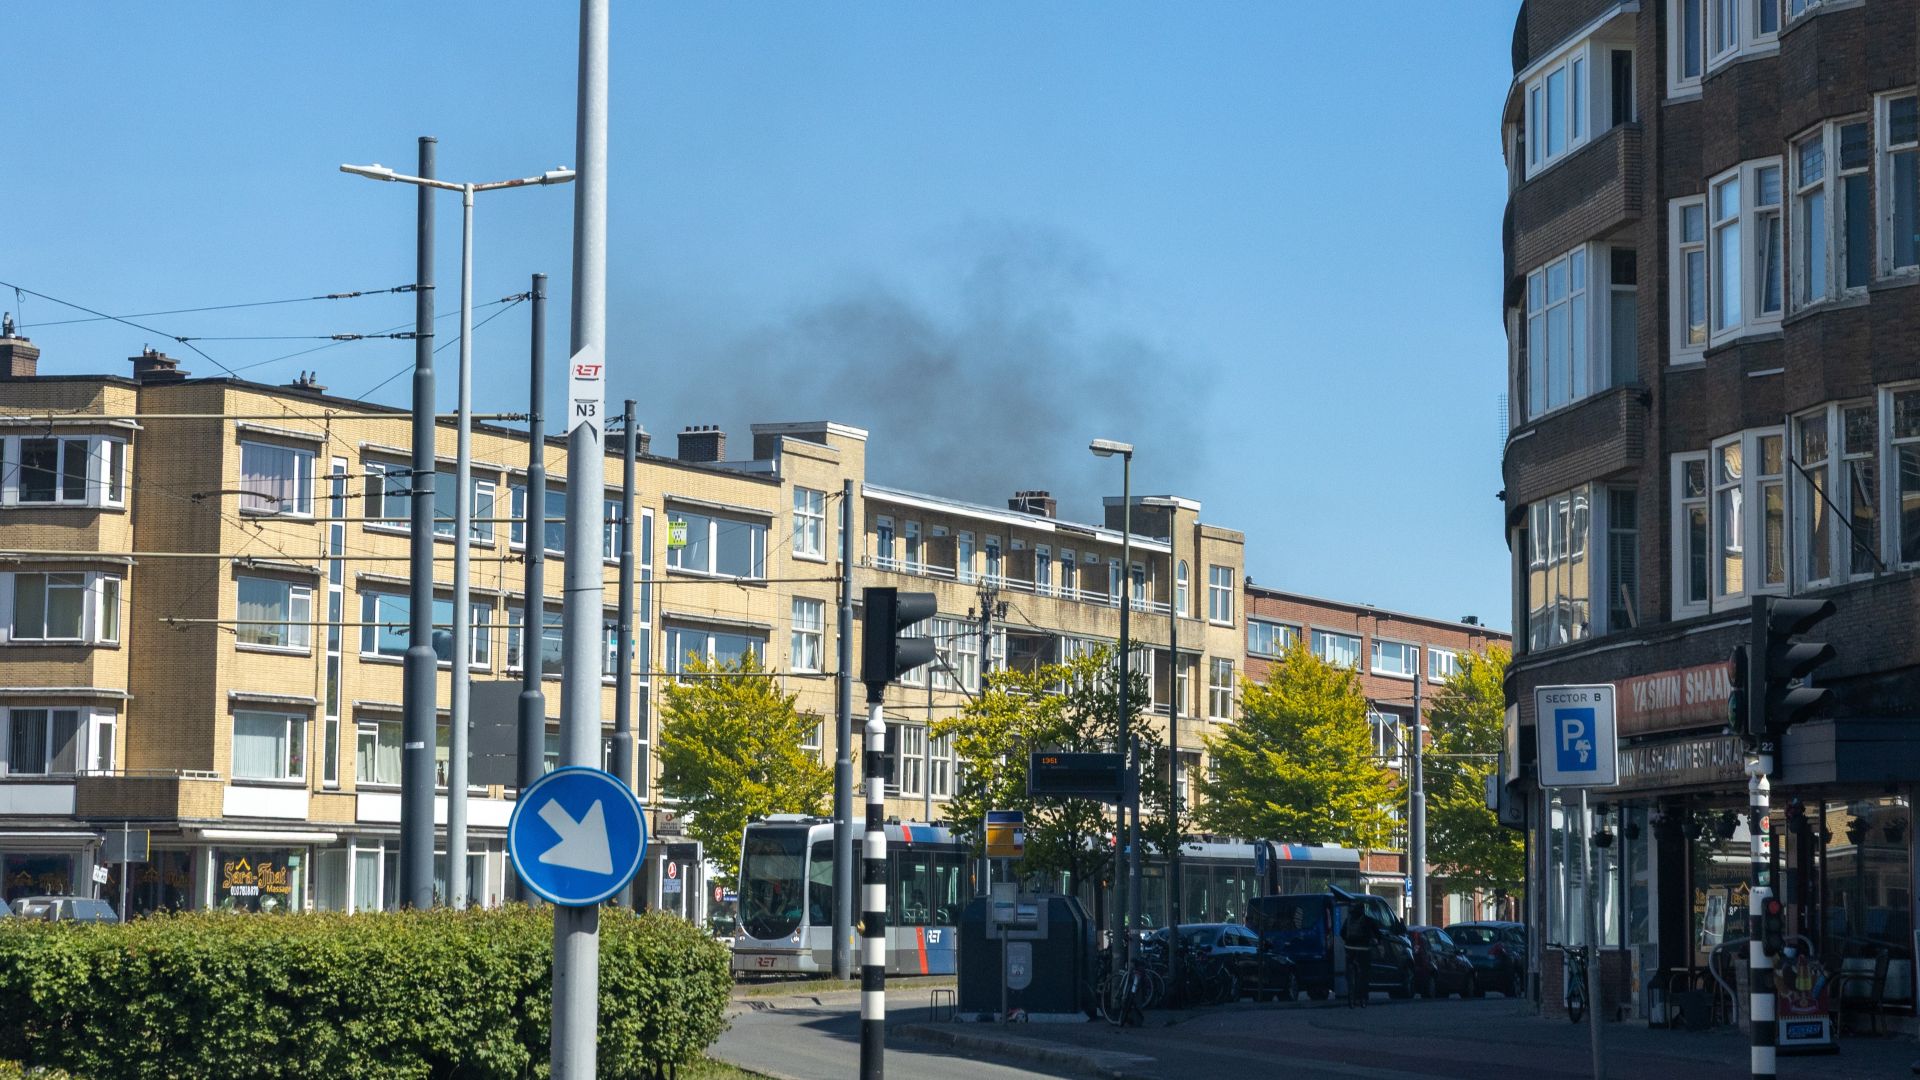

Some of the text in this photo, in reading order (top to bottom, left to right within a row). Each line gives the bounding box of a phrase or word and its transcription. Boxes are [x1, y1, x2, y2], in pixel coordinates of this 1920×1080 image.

[572, 364, 602, 376] RET
[576, 404, 596, 417] N3
[1546, 693, 1602, 704] SECTOR B
[1632, 675, 1681, 713] YASMIN
[1562, 719, 1585, 752] P
[1762, 742, 1773, 751] 22
[927, 929, 942, 943] RET
[756, 956, 777, 967] RET
